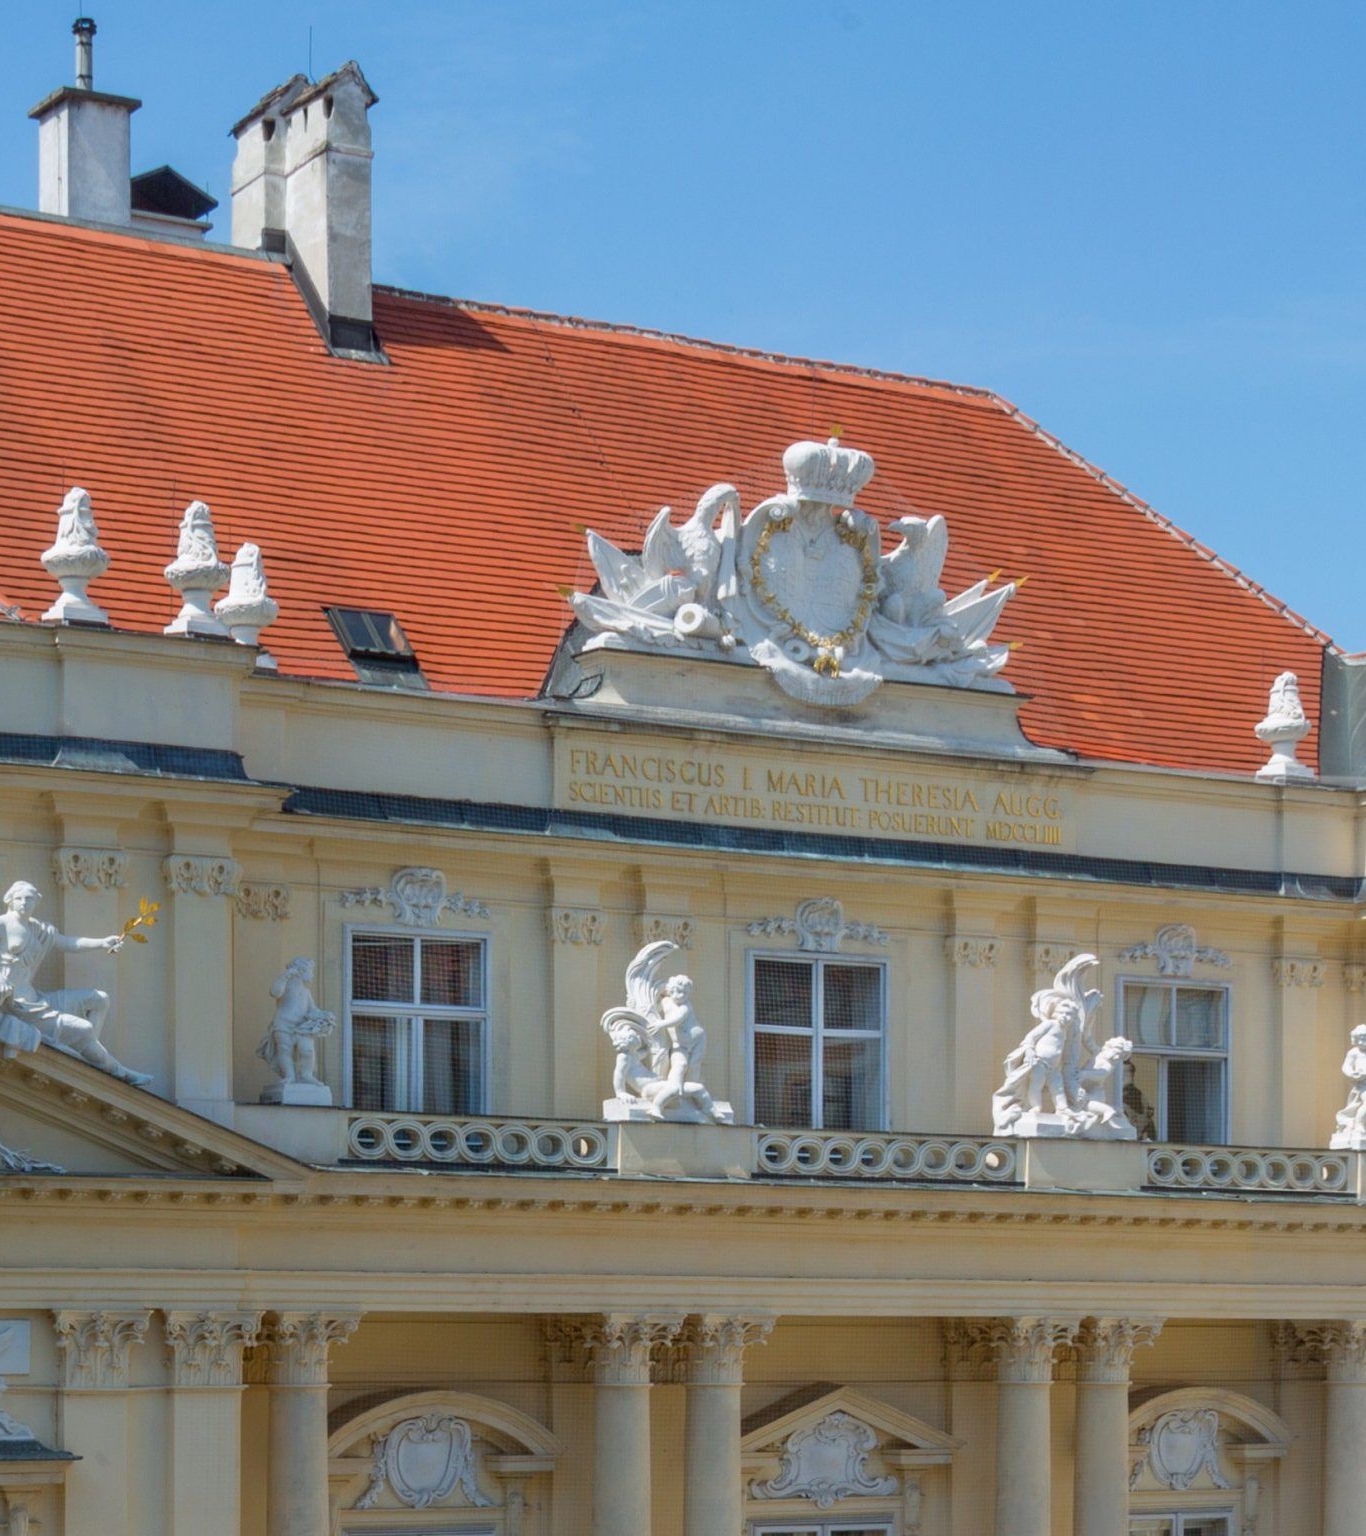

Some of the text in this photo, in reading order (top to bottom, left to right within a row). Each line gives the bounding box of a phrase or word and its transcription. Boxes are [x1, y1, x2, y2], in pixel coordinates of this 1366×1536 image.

[569, 781, 663, 809] SCIENTIIS
[671, 791, 698, 813] ET
[570, 749, 725, 787] FRANCISCUS
[767, 769, 847, 800] MARIA
[859, 776, 980, 813] THERESIA
